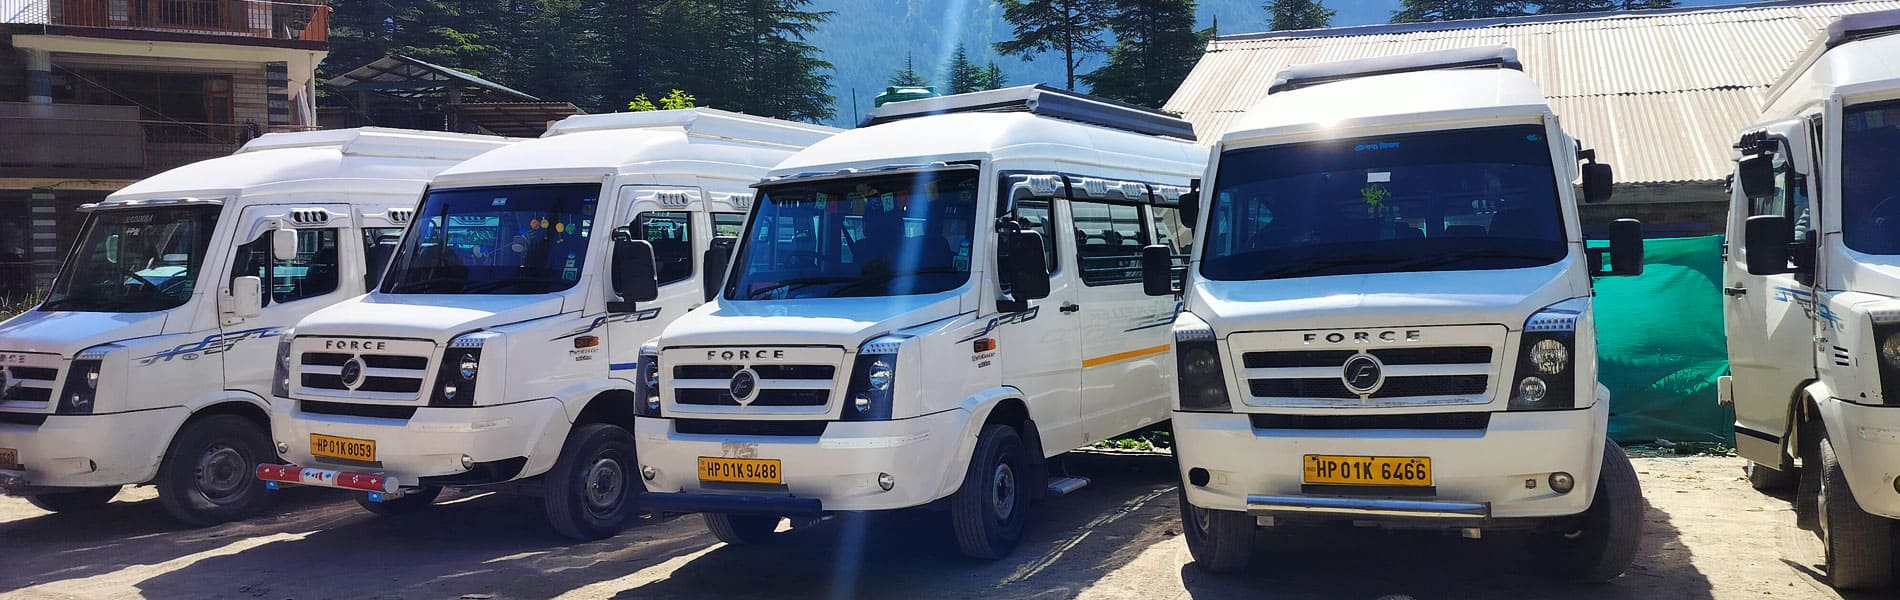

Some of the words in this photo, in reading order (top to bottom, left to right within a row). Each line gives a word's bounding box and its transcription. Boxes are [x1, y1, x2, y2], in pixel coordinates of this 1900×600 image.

[1304, 330, 1420, 344] FORCE
[326, 340, 385, 350] FORCE
[707, 350, 783, 360] FORCE
[347, 442, 372, 458] 8053
[746, 463, 777, 479] 9488
[1381, 462, 1426, 480] 6466
